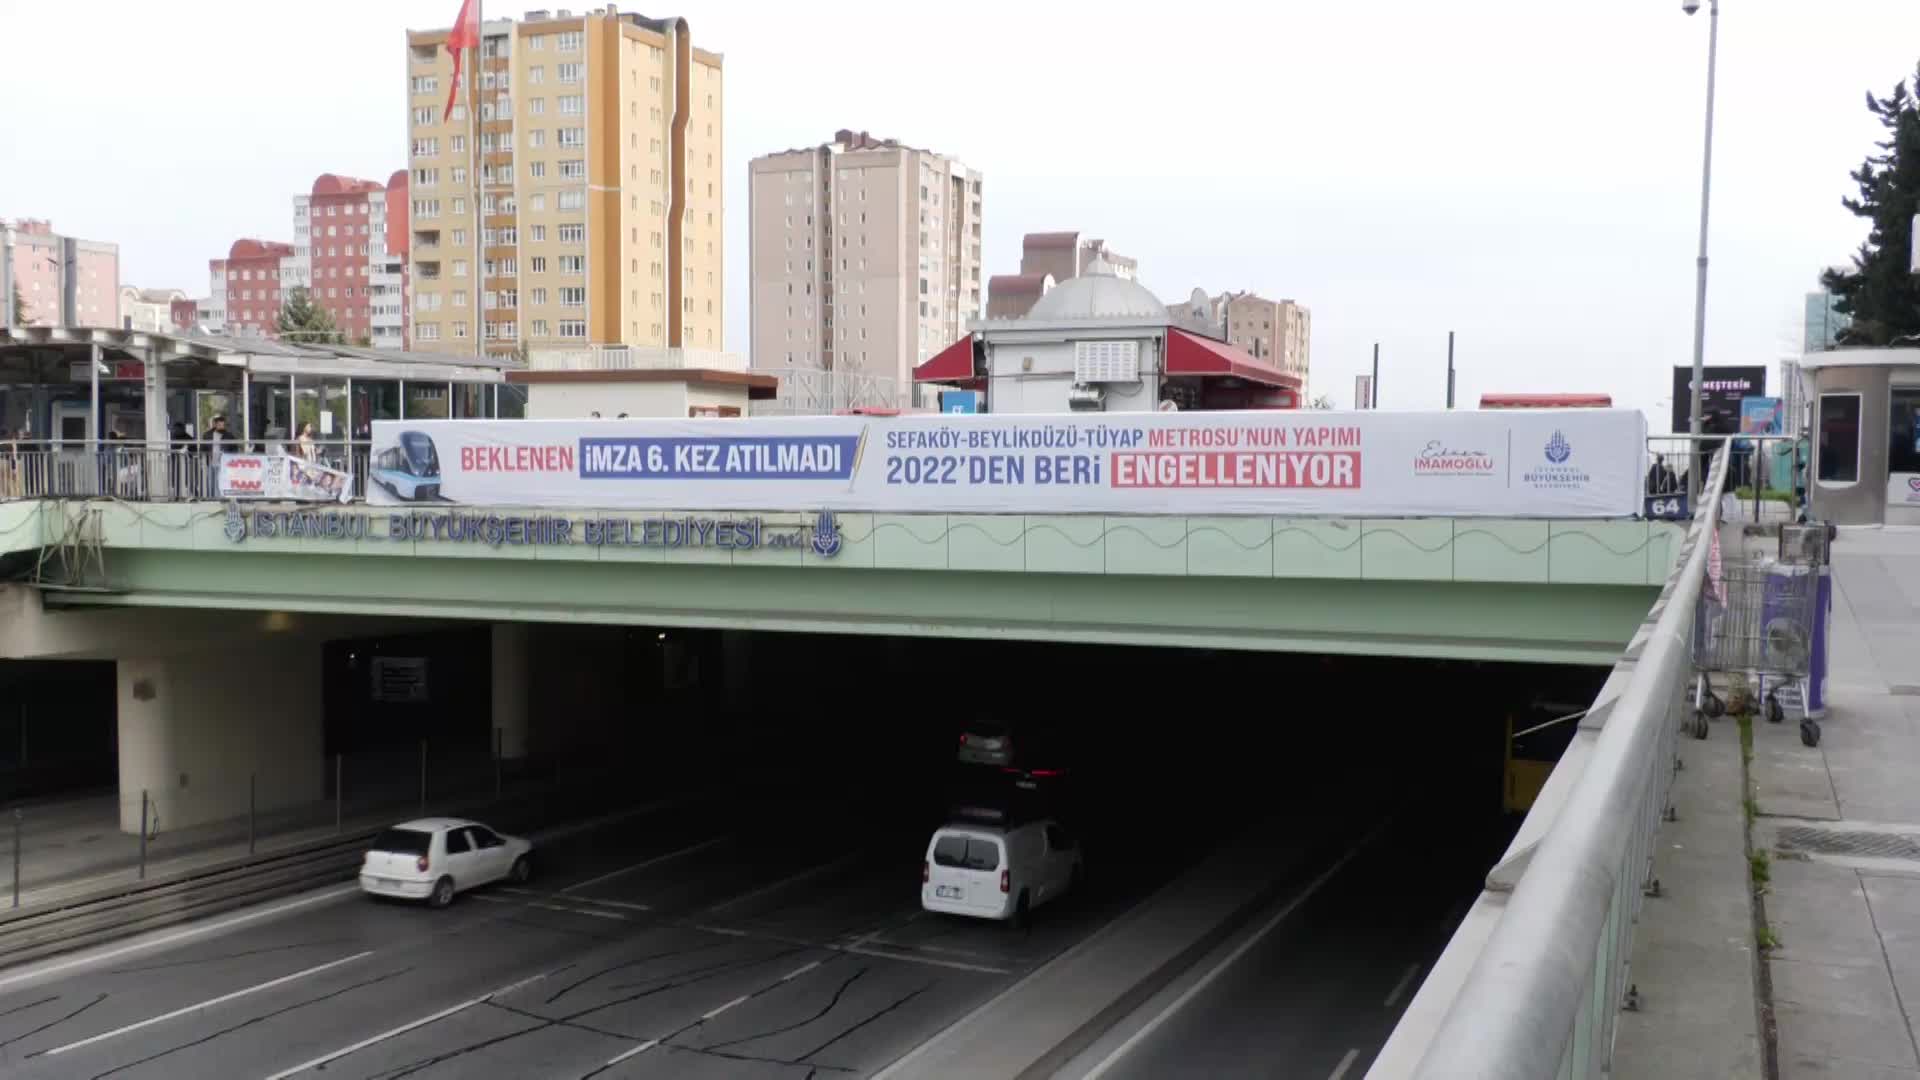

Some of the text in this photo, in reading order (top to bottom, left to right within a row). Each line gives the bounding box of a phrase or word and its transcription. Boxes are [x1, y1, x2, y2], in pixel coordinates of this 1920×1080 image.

[886, 425, 1361, 448] SEFAKÖY-BEYLİKDÜZÜ-TÜYAP METROSU'NUN YAPIMI
[460, 446, 574, 472] BEKLENEN
[647, 445, 669, 472] 6.
[675, 444, 719, 472] KEZ
[725, 443, 841, 472] ATILMADI
[886, 455, 1025, 485] 2022'DEN
[1652, 499, 1680, 514] 64
